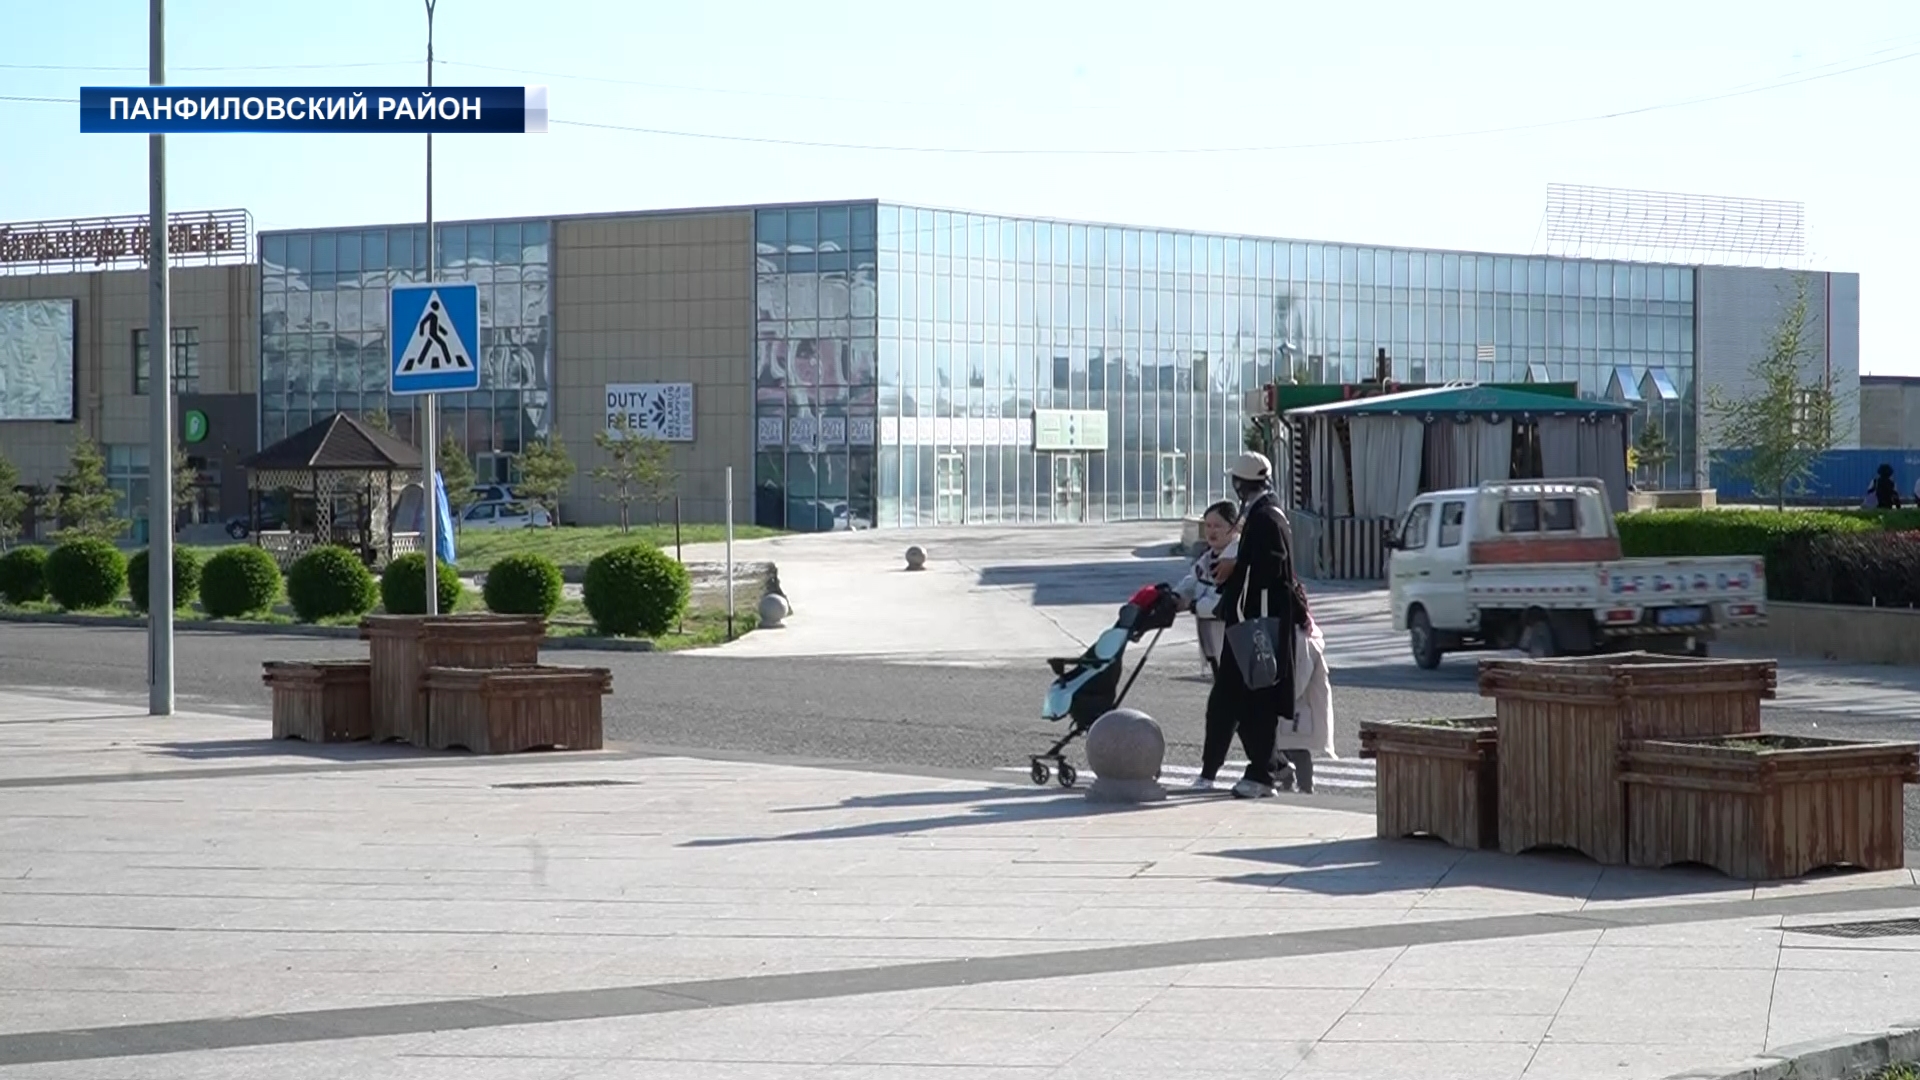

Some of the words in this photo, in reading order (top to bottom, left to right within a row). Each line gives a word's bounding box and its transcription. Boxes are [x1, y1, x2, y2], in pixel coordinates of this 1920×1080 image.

[132, 222, 230, 264] оралығы
[607, 392, 647, 408] DUTY
[607, 413, 648, 429] FEE
